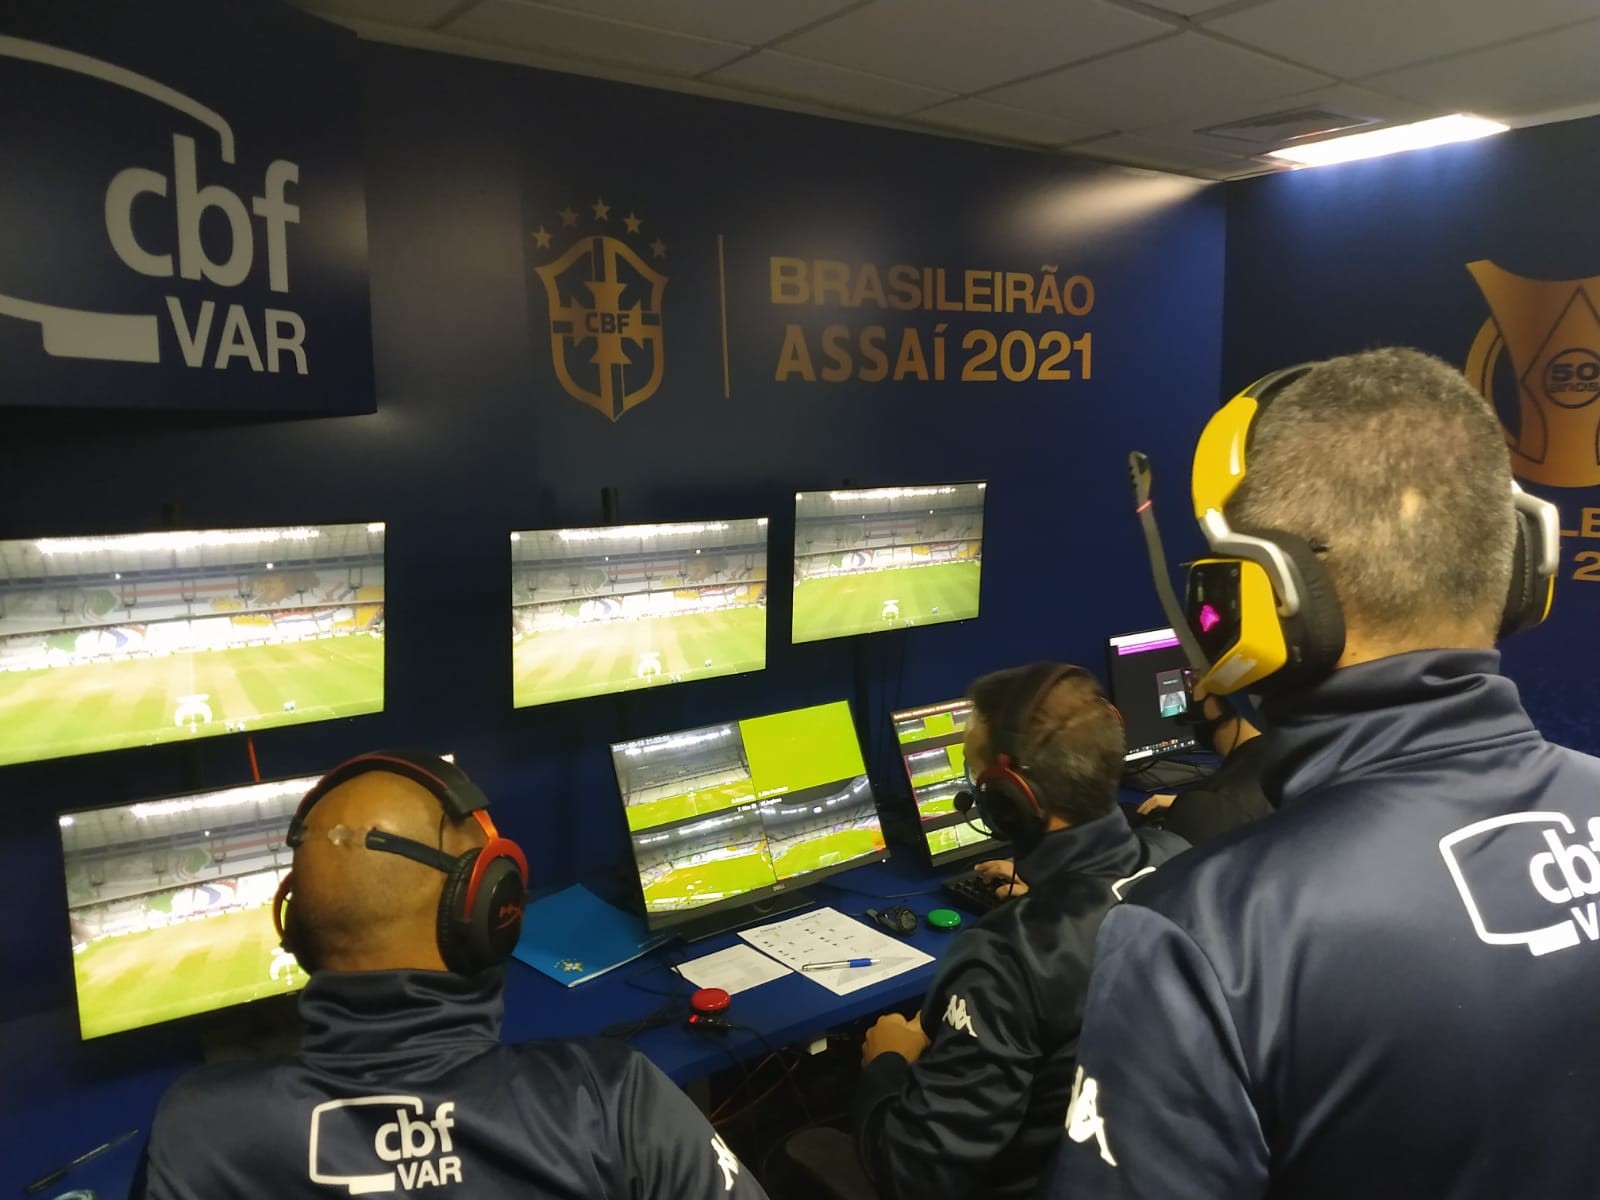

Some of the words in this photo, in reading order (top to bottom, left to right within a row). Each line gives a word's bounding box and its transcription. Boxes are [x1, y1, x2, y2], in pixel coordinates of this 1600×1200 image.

[106, 134, 300, 293] cbf
[770, 258, 1095, 315] BRASILEIRÃO
[165, 296, 309, 375] VAR
[586, 312, 630, 333] CBF
[775, 325, 946, 382] ASSAÍ
[961, 330, 1093, 382] 2021
[1552, 363, 1600, 381] 50
[376, 1102, 455, 1162] cbf
[398, 1157, 462, 1190] VAR
